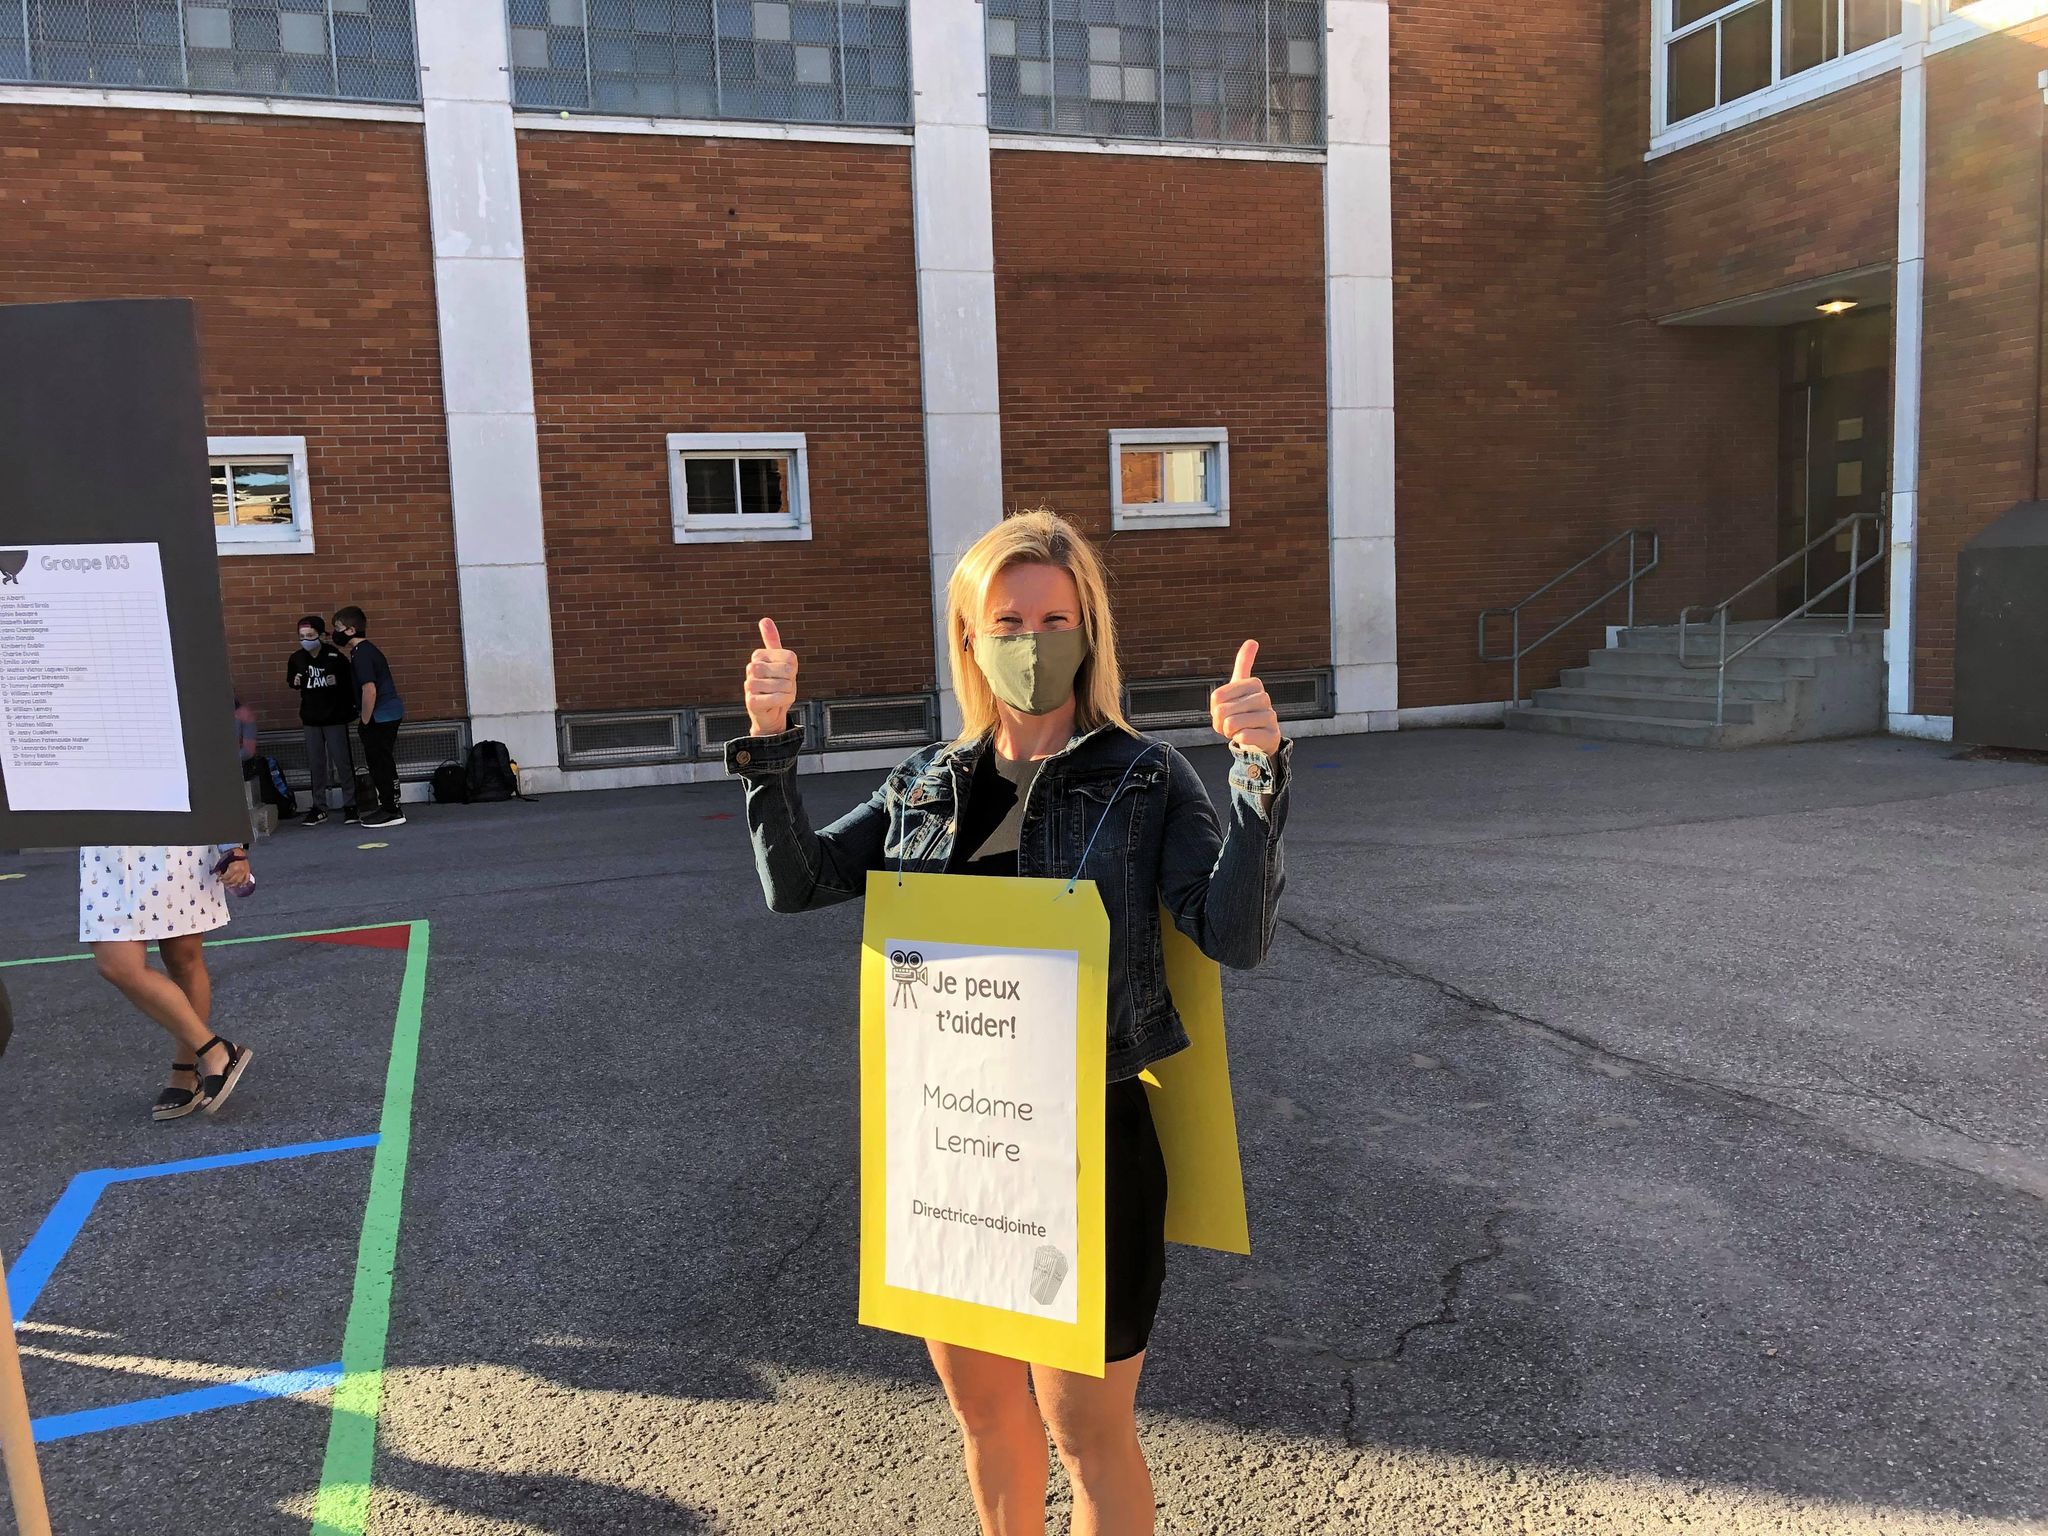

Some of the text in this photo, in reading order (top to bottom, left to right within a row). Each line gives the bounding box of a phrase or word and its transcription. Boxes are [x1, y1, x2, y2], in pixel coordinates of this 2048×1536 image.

[41, 555, 130, 573] Groupe 103
[308, 665, 325, 678] OUT
[933, 971, 1021, 1001] Je peux
[936, 1009, 1017, 1040] t'aider!
[923, 1083, 1034, 1121] Madame
[935, 1126, 1021, 1162] Lemire
[912, 1199, 1048, 1238] Directrice-adjointe
